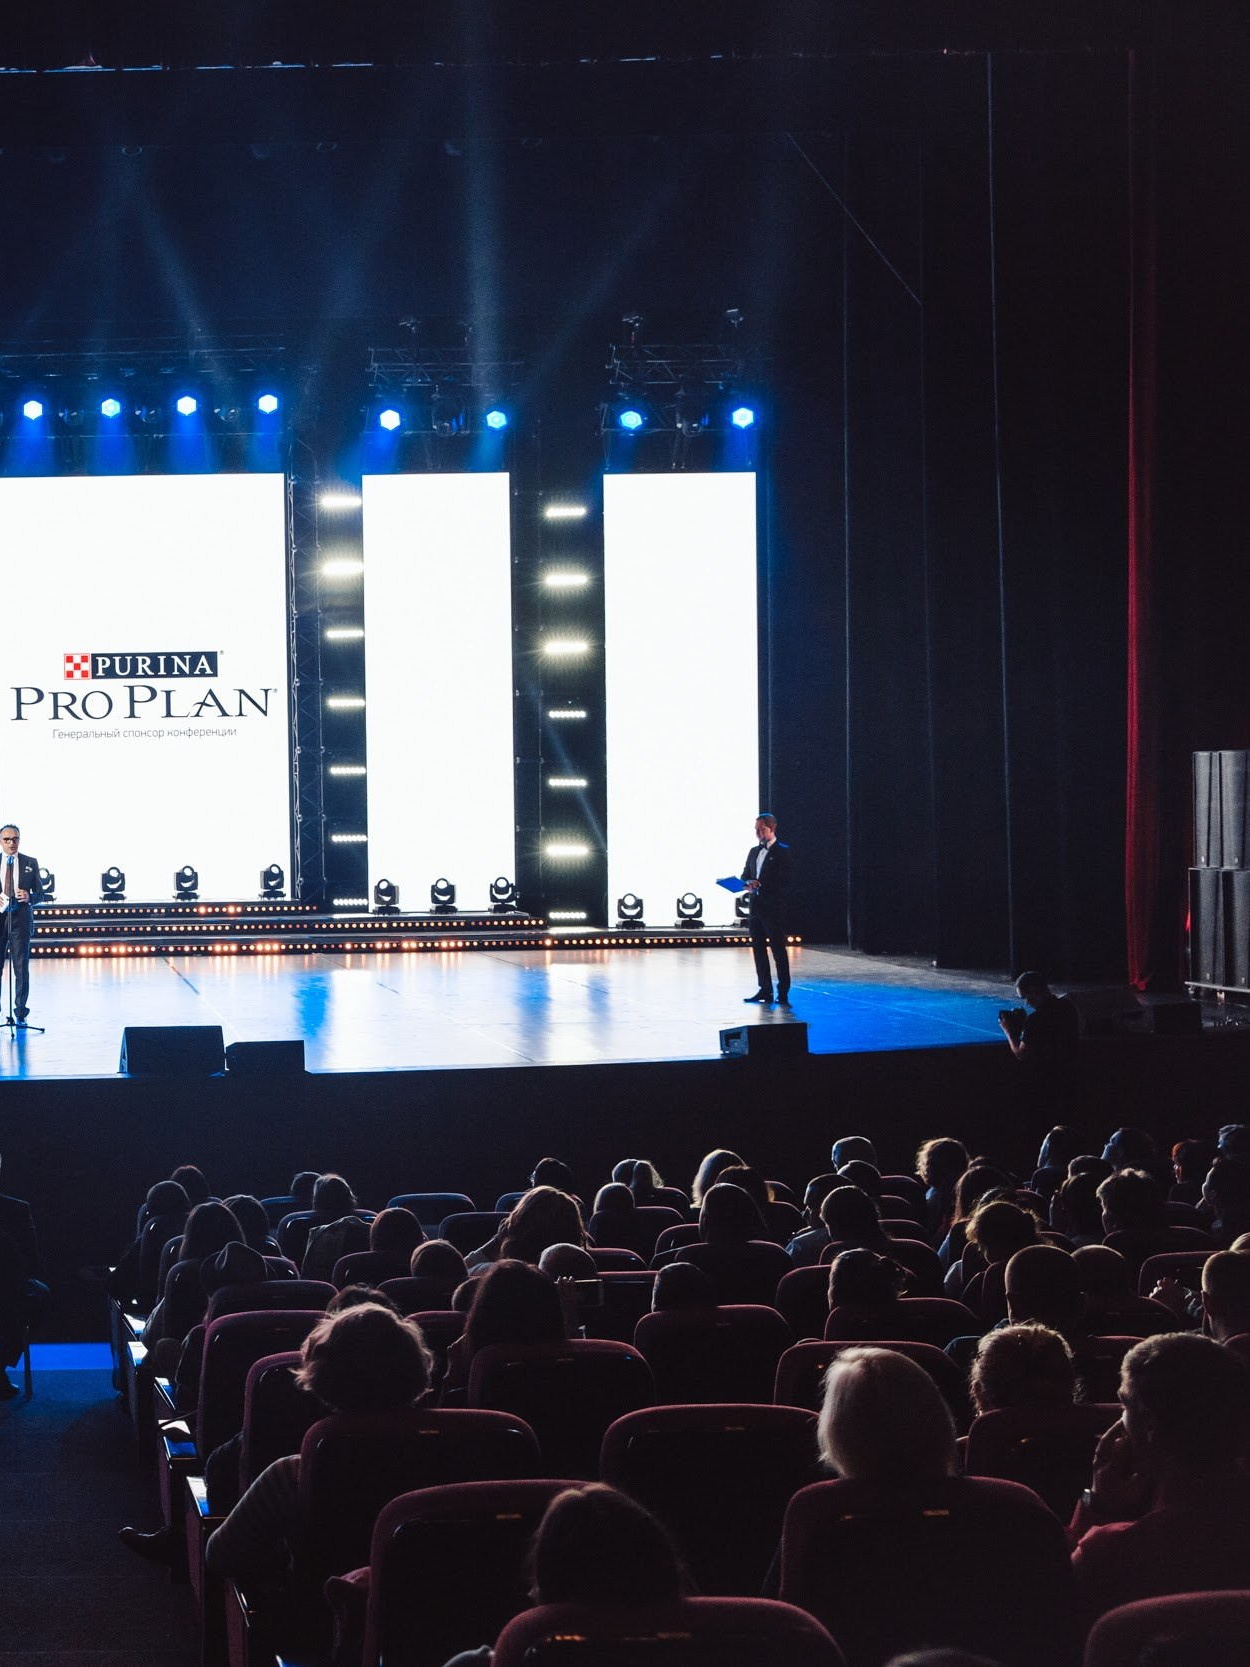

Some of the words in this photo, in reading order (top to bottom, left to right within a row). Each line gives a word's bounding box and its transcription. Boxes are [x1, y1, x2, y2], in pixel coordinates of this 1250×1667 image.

[95, 654, 214, 677] PURINA
[10, 686, 113, 721] PRO
[123, 684, 272, 719] PLAN
[52, 728, 121, 741] Генеральный
[123, 728, 165, 739] спонсор
[167, 727, 237, 739] конференции
